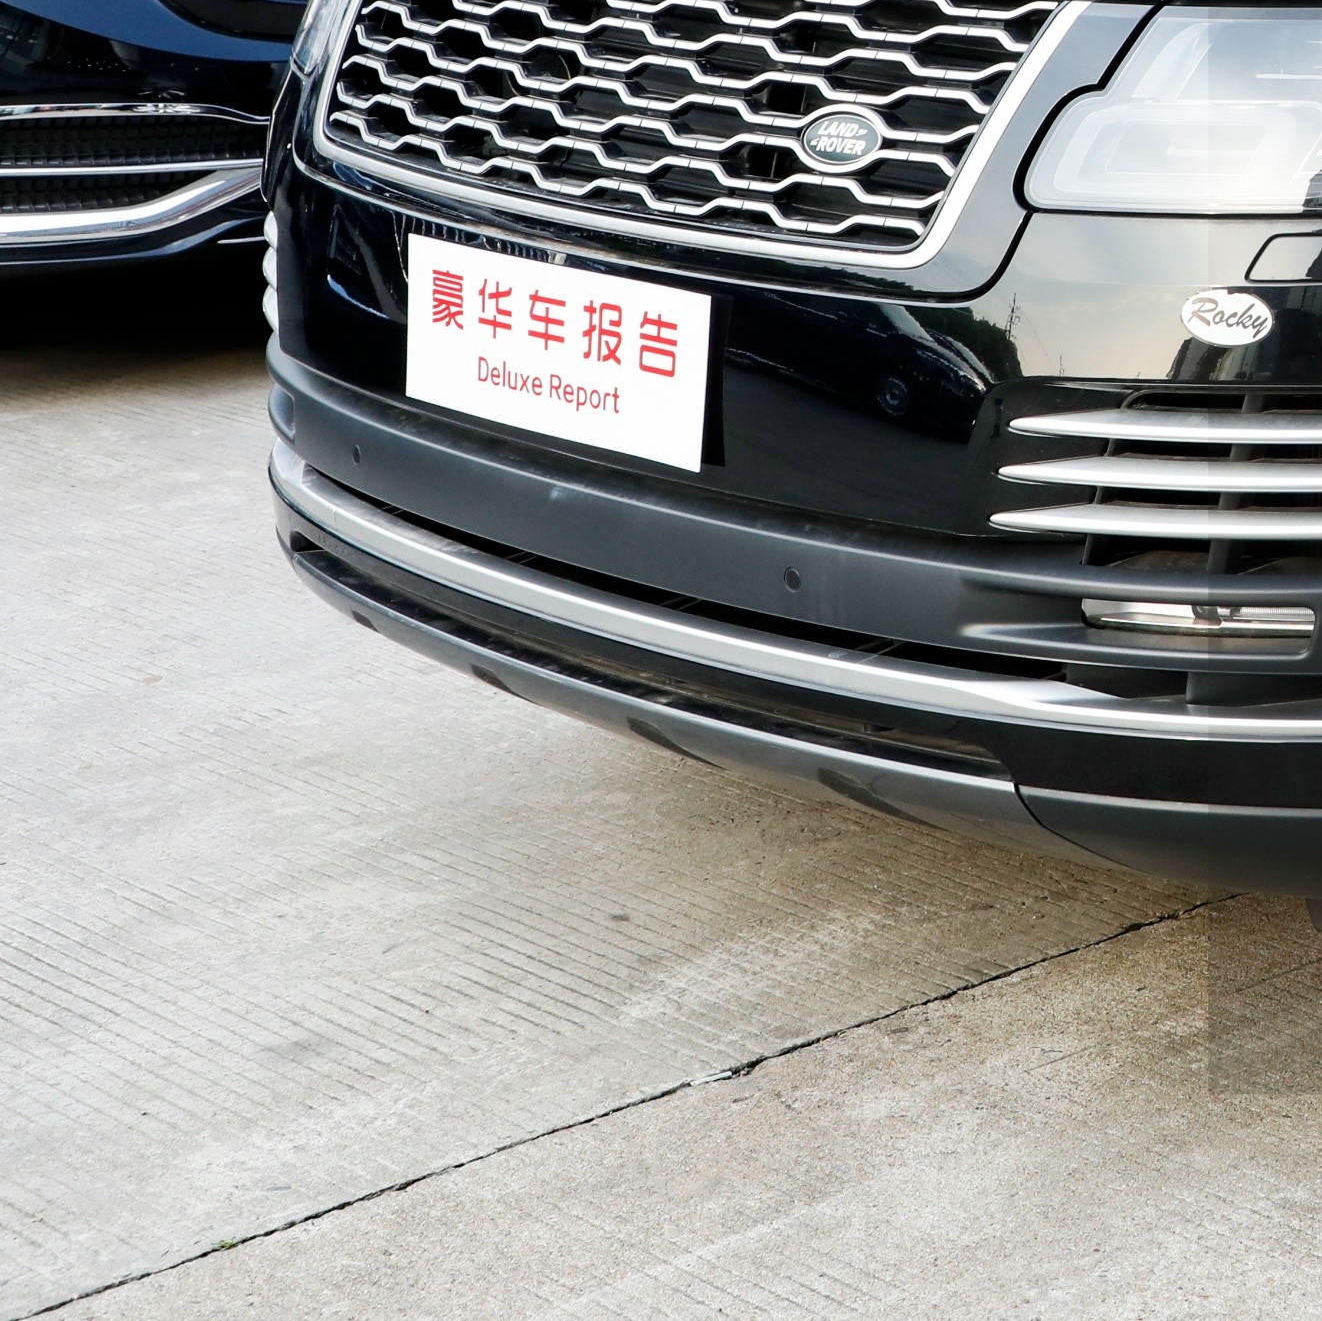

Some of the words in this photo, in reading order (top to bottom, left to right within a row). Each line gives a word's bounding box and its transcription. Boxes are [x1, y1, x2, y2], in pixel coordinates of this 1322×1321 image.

[815, 137, 867, 156] ROVER
[818, 121, 860, 137] LAND
[432, 269, 678, 378] 豪华车报告
[1187, 296, 1269, 339] Rocky
[477, 356, 543, 396] Deluxe
[549, 373, 620, 414] Report
